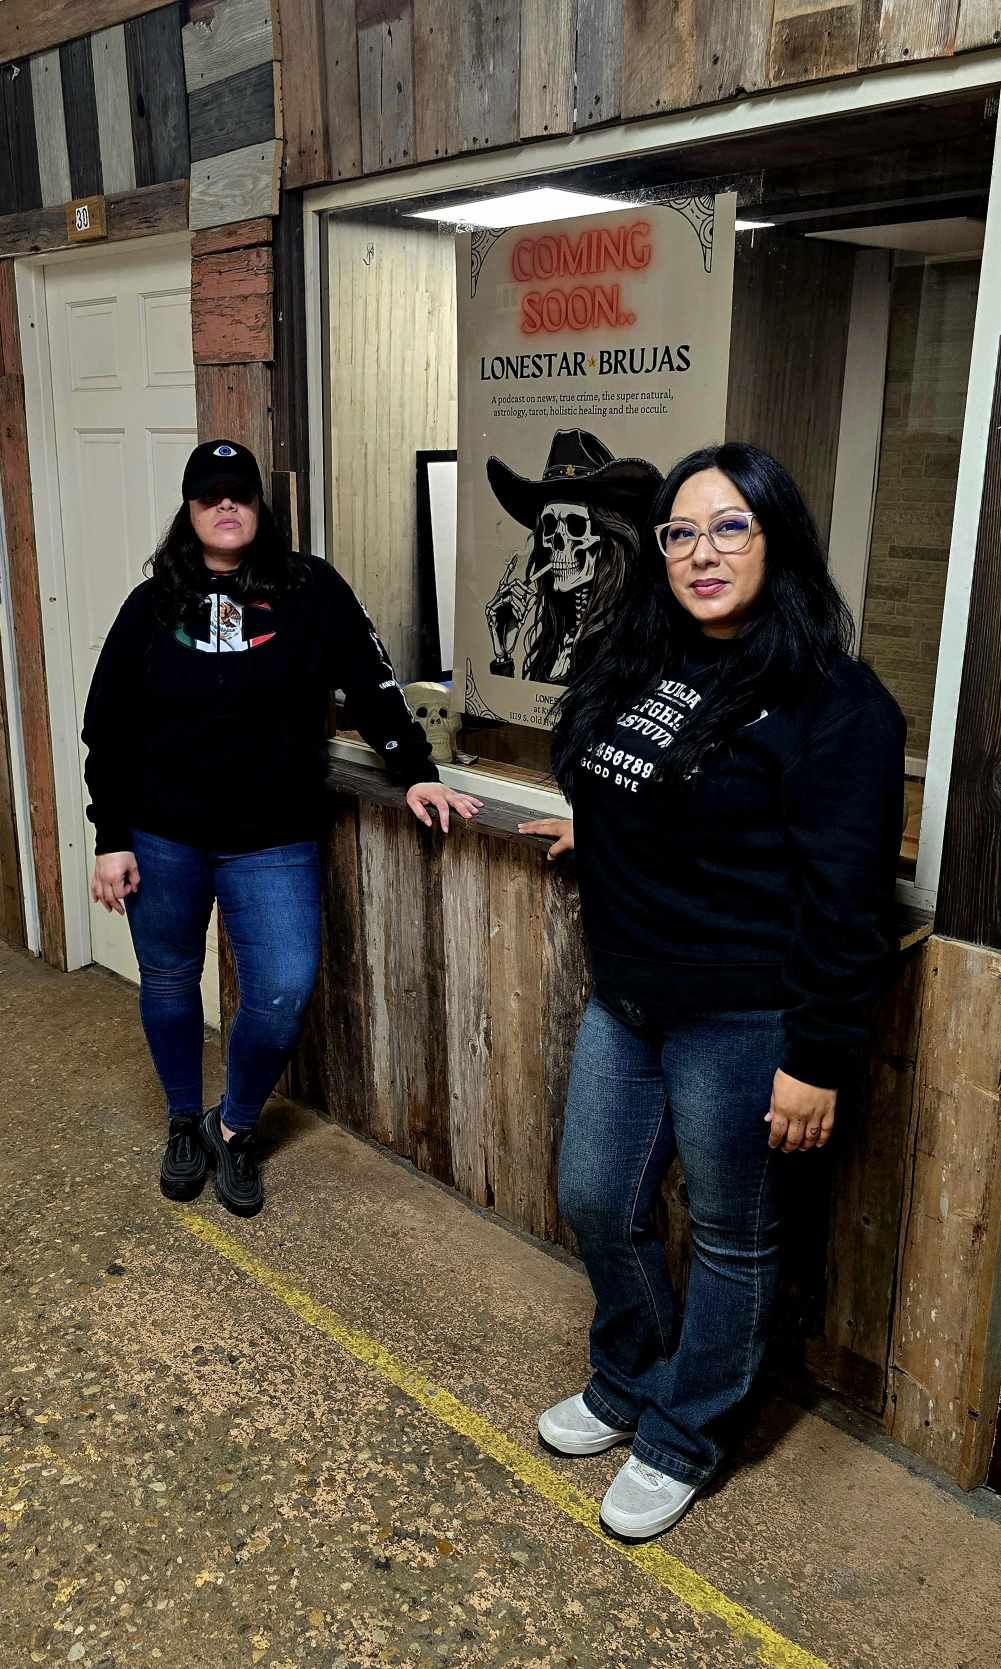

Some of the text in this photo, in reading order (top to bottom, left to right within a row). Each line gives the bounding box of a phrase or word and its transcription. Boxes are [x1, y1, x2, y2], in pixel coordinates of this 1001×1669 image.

[77, 207, 88, 229] 30
[512, 222, 651, 282] COMING
[480, 345, 691, 380] LONESTAR BRUJAS
[491, 396, 497, 404] A
[498, 394, 525, 406] podcast
[537, 395, 558, 404] news,
[559, 394, 575, 402] true
[576, 391, 600, 402] crime,
[602, 391, 615, 400] the
[616, 392, 639, 403] super
[640, 388, 673, 400] natural,
[493, 403, 668, 418] astrology, tarot, holistic healing and the occult.
[535, 694, 560, 705] LONES
[530, 715, 542, 725] Old
[614, 773, 639, 792] BYE
